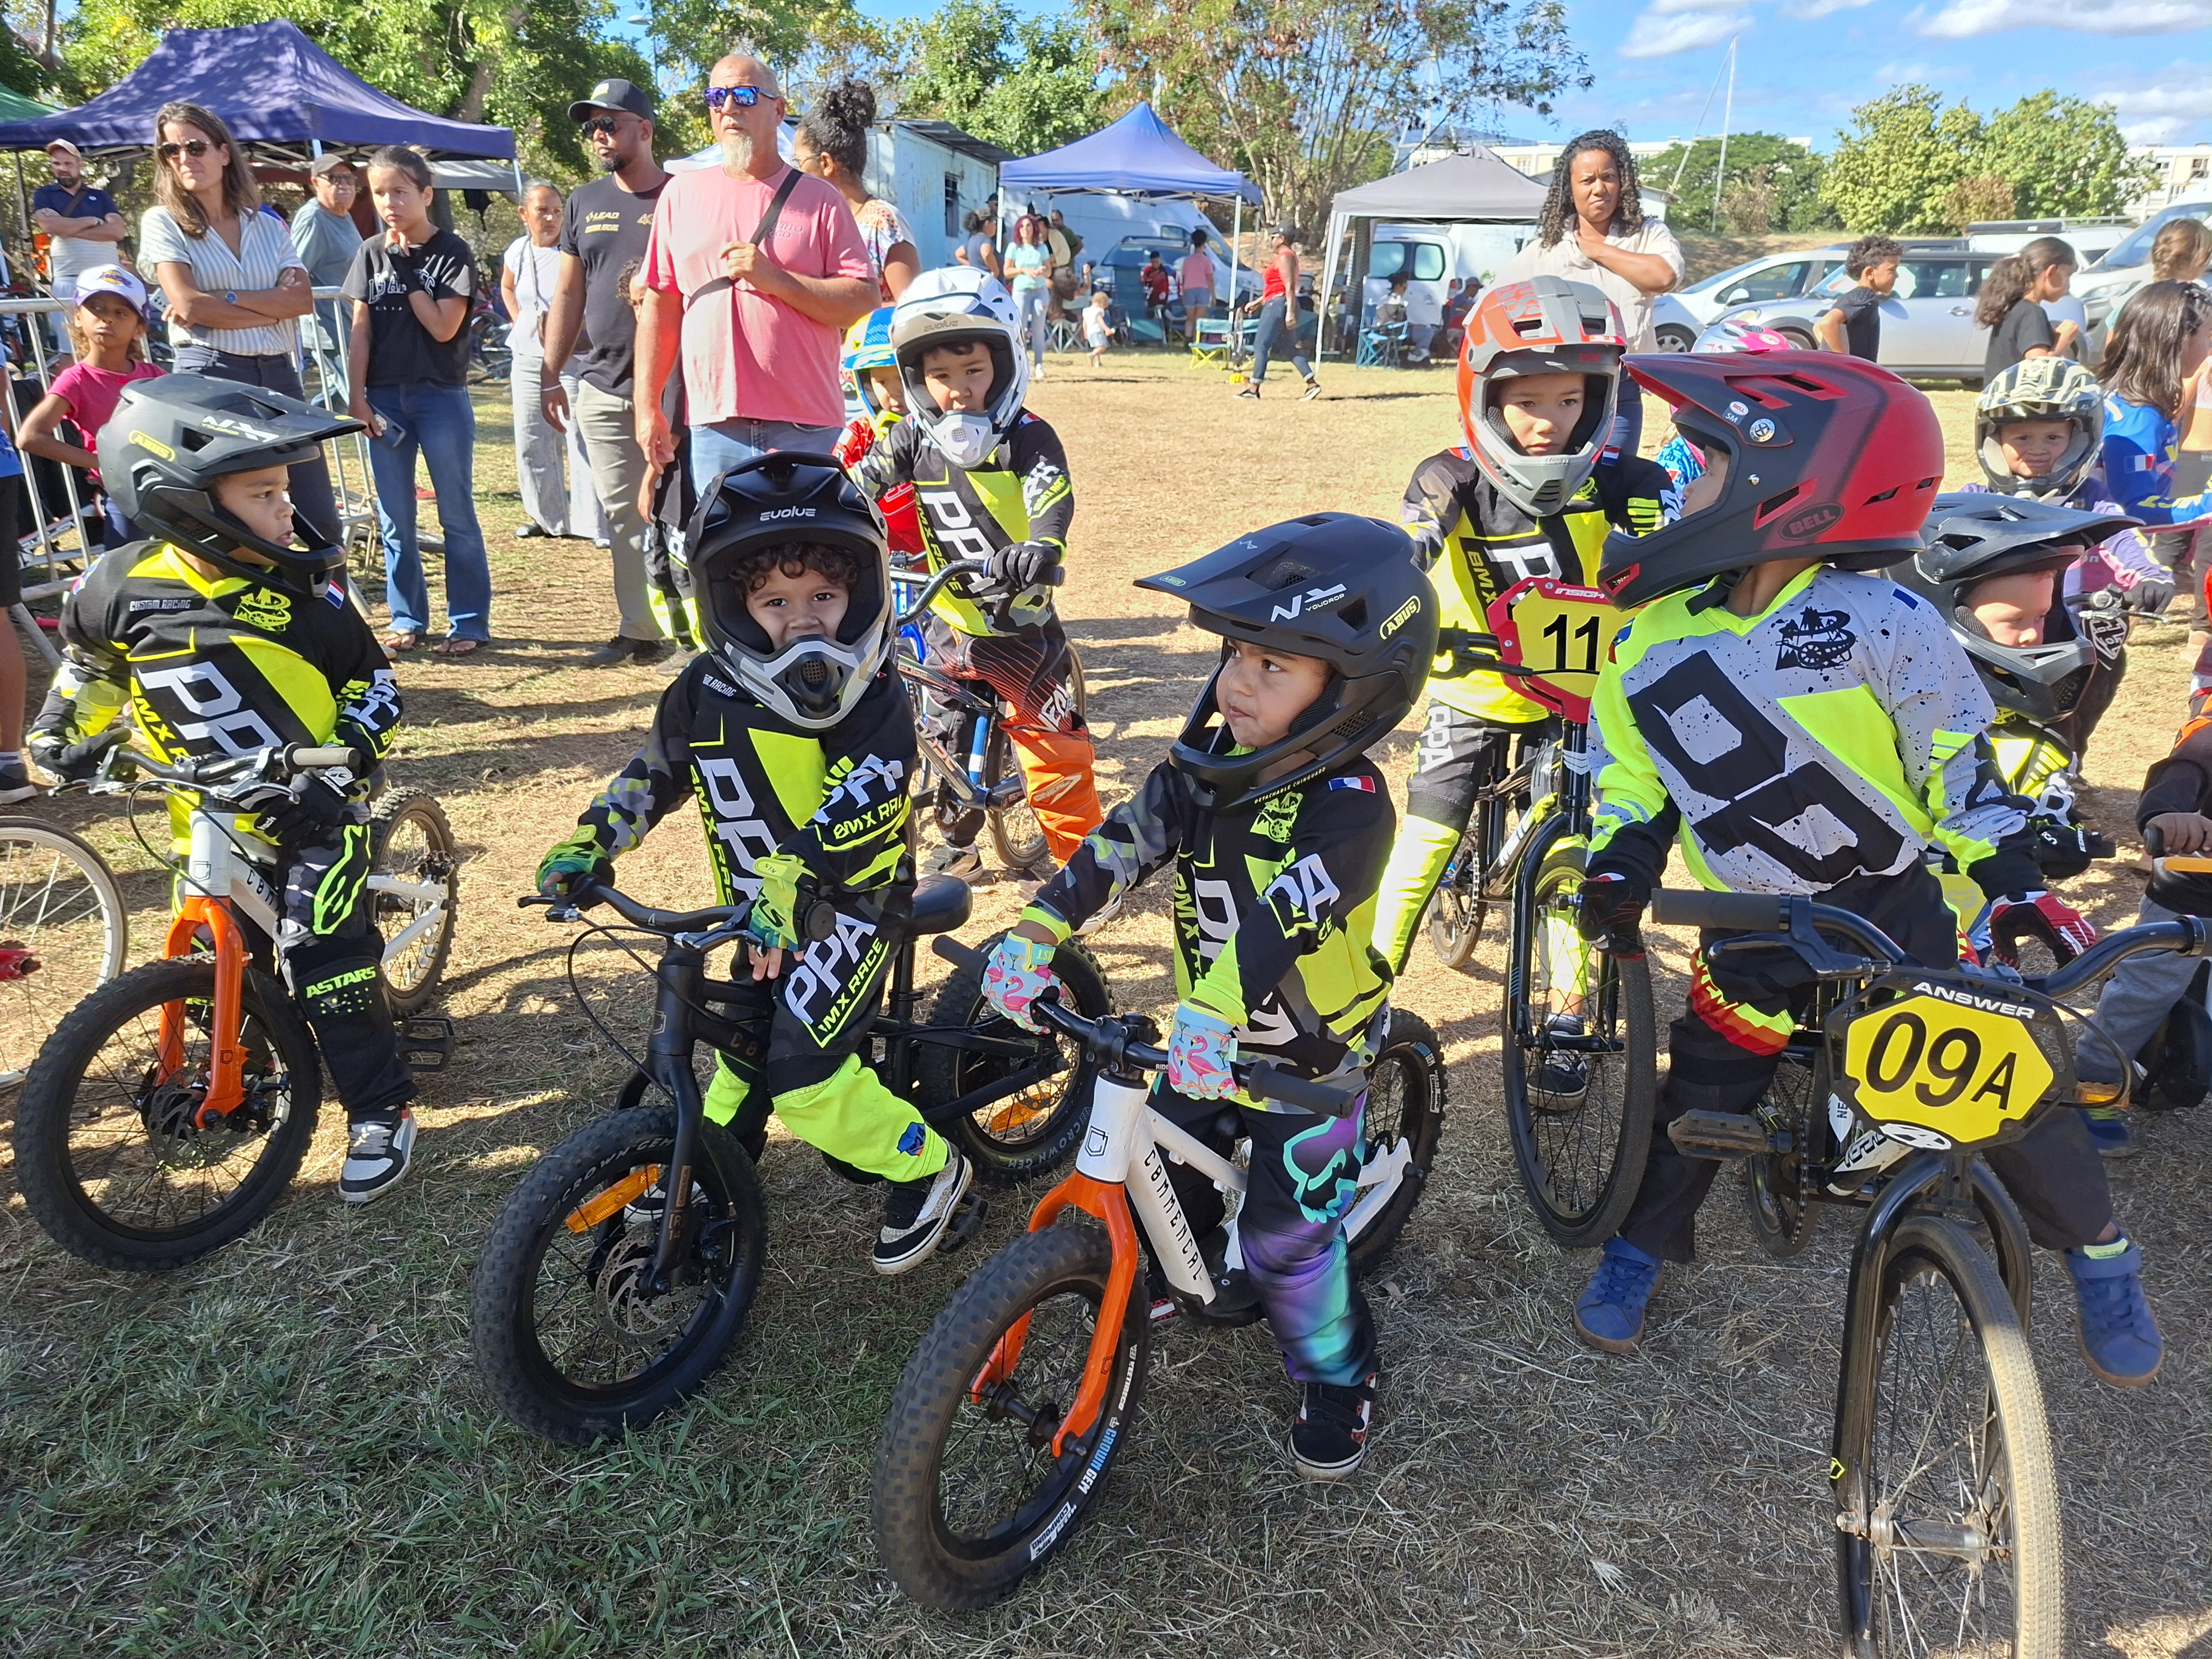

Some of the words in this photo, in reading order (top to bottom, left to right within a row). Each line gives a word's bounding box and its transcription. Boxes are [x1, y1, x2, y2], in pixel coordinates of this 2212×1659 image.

[1725, 413, 1738, 423] SM
[1733, 403, 1746, 414] BELL
[133, 434, 170, 460] ABUS
[1788, 509, 1836, 535] BELL
[1164, 576, 1183, 585] ABUS
[1467, 551, 1497, 604] BMX
[1554, 587, 1605, 599] INSIGH
[1306, 593, 1345, 612] YOUDROP
[1386, 599, 1418, 635] ABUS
[1543, 613, 1600, 670] 11
[130, 676, 177, 742] BMX
[689, 764, 718, 836] BMX
[1254, 784, 1291, 805] DETACHABLE
[1292, 766, 1326, 788] CHINGUARD
[833, 810, 877, 840] BMX
[1173, 872, 1200, 940] BMX
[305, 966, 377, 999] ASTARS
[847, 937, 883, 994] RACE
[1912, 982, 2035, 1019] ANSWER
[1039, 1121, 1082, 1164] CROWN
[561, 1146, 632, 1203] CROWN
[637, 1137, 675, 1151] GEM
[1008, 1157, 1033, 1170] GEM
[1144, 1149, 1203, 1282] COMMENCAL
[1091, 1427, 1117, 1471] CROWN
[1078, 1468, 1098, 1495] GEM
[1031, 1505, 1069, 1550] COMPOUND
[1035, 1536, 1052, 1556] MPC
